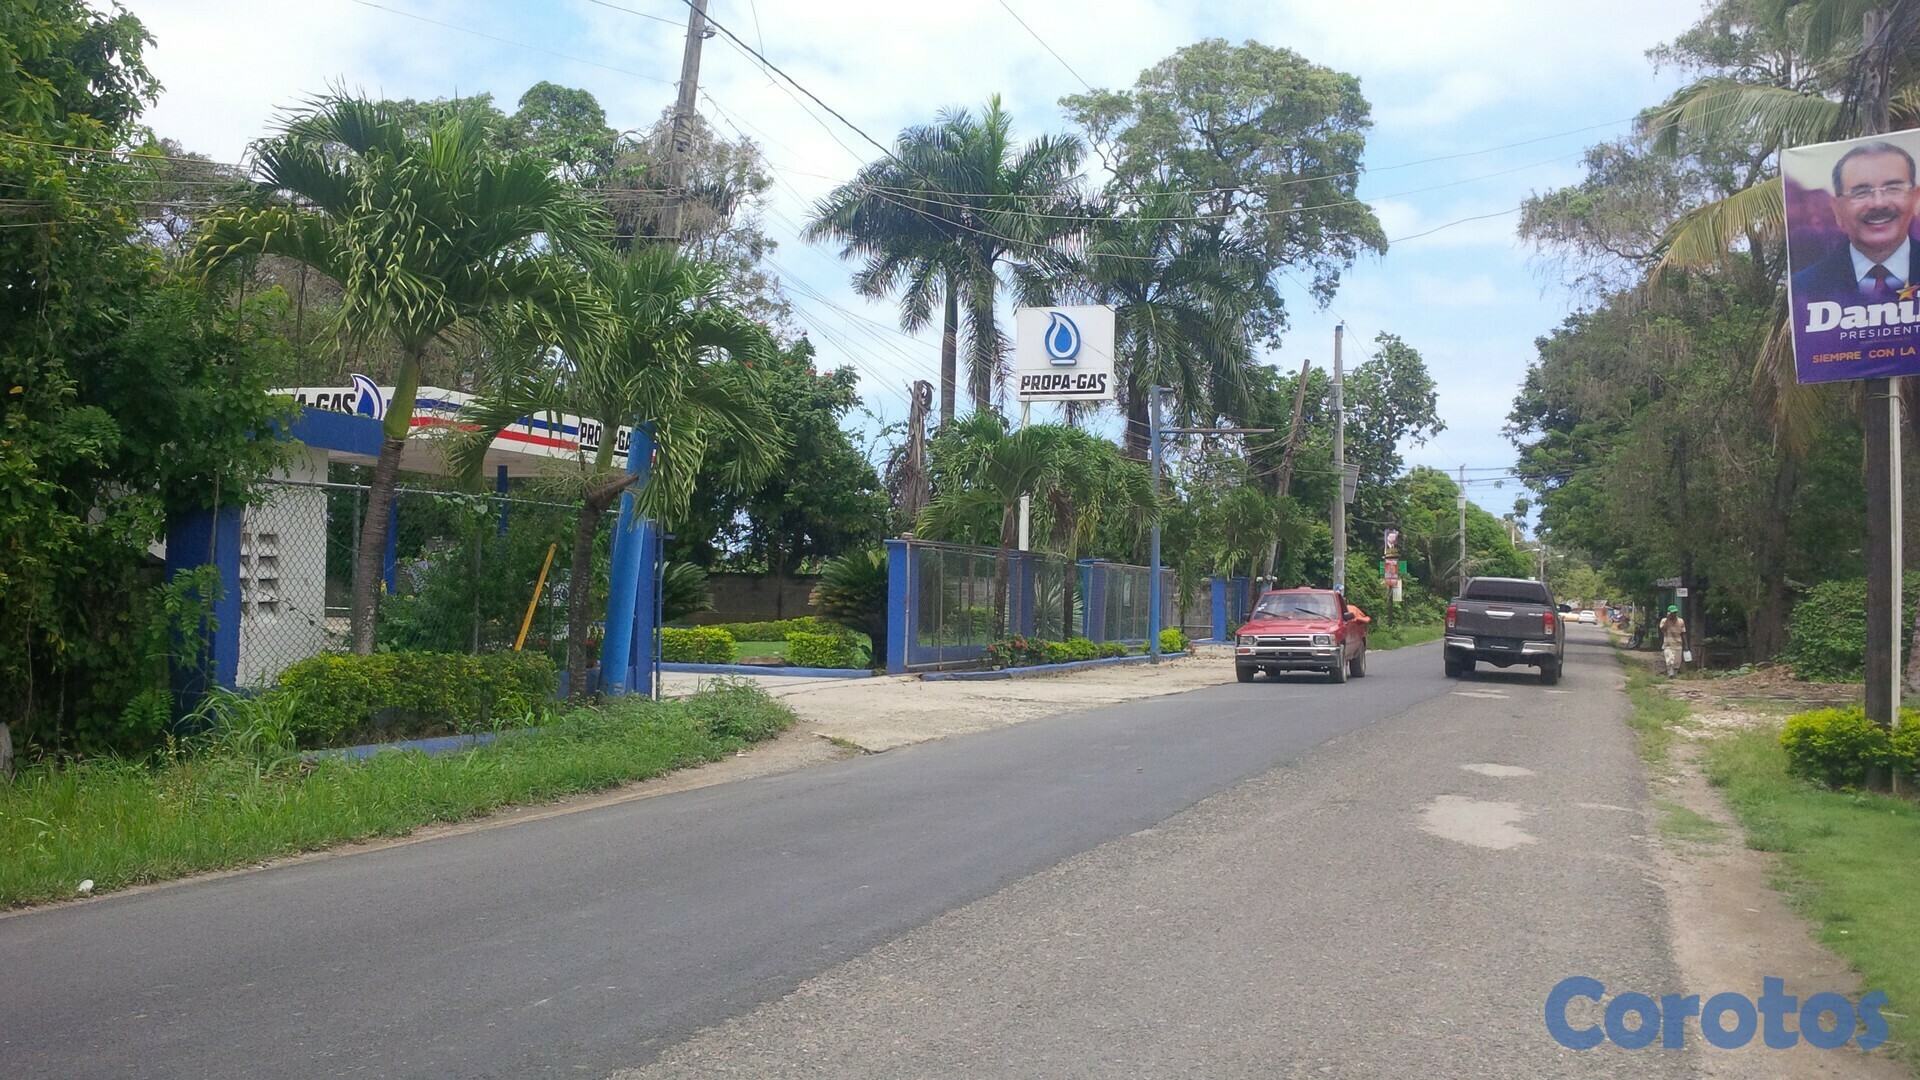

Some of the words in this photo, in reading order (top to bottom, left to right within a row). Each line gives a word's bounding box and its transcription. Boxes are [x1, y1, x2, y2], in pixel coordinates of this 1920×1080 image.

[1812, 351, 1861, 363] SIEMPRE
[1869, 348, 1895, 359] CON
[1900, 346, 1916, 356] LA
[1020, 373, 1107, 395] PROPA-GAS
